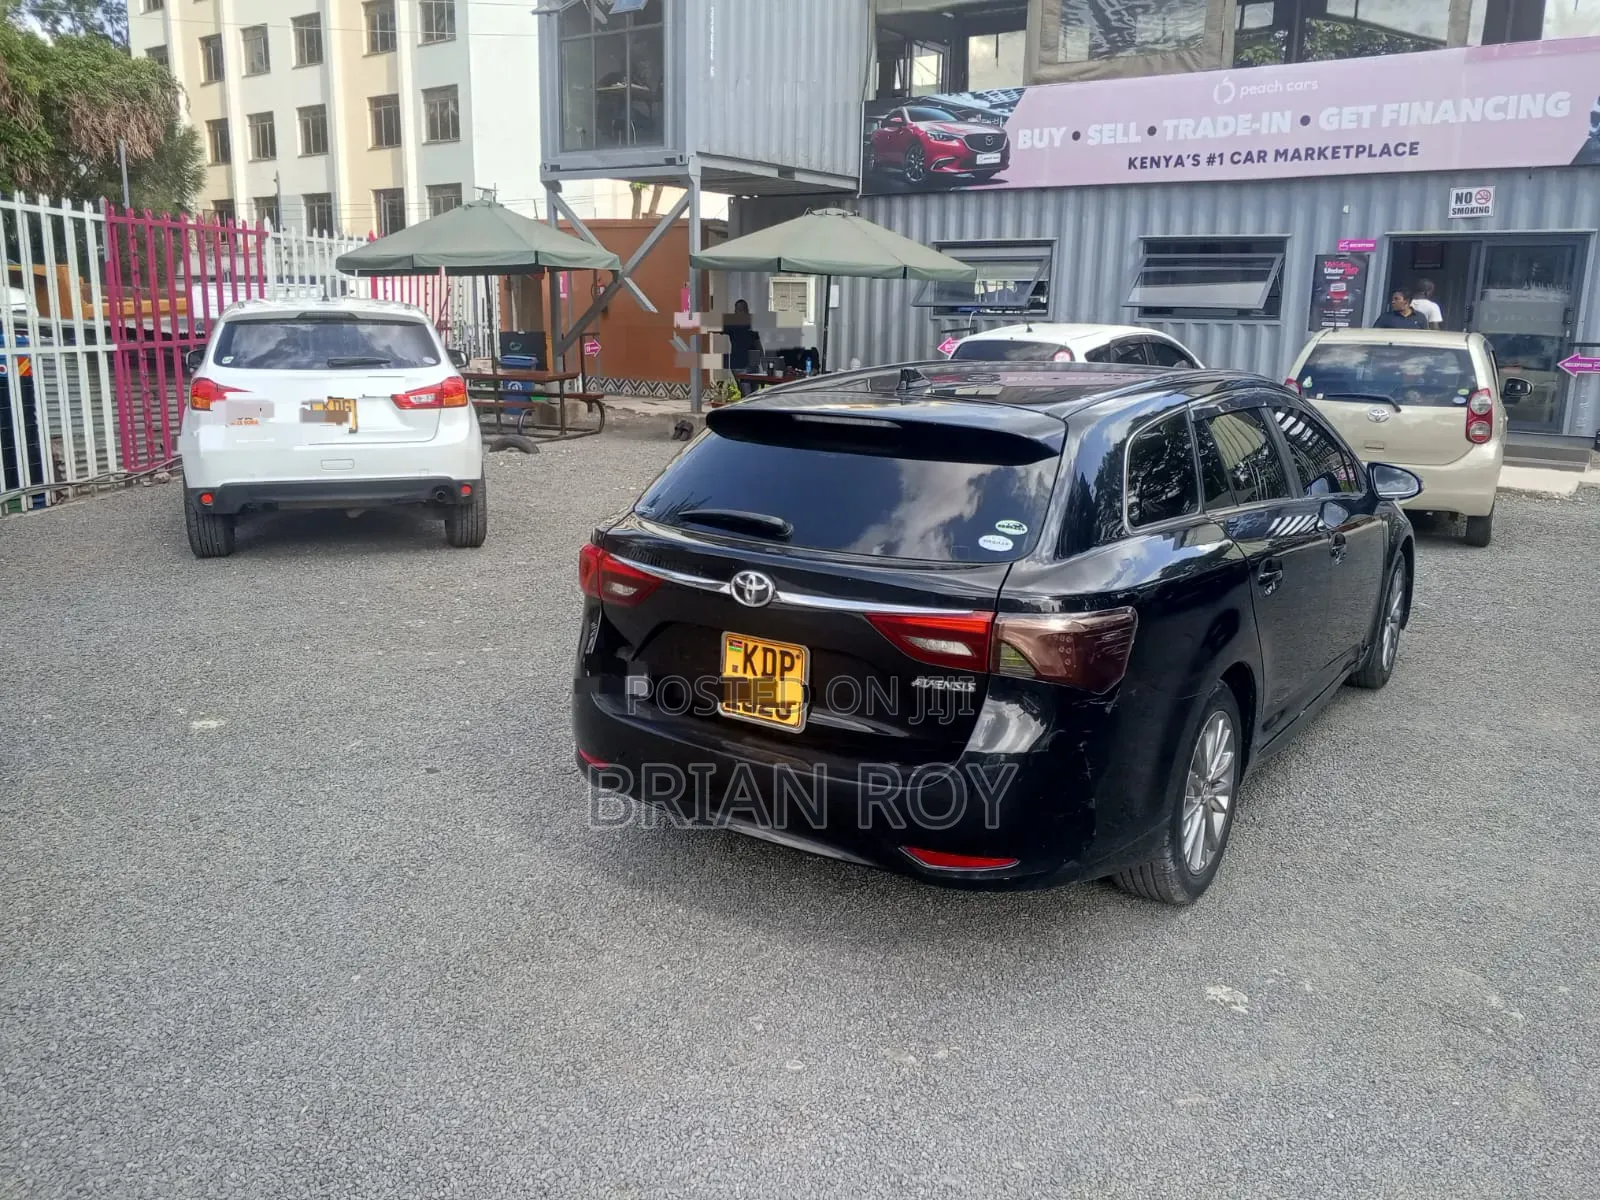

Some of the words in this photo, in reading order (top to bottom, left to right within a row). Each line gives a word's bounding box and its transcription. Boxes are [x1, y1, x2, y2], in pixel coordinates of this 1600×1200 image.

[1240, 79, 1282, 99] peach
[1287, 78, 1319, 92] cars
[1017, 127, 1068, 150] BUY
[1087, 122, 1142, 146] SELL
[1162, 110, 1293, 142] TRADE-IN
[1318, 104, 1377, 131] GET
[1381, 91, 1571, 128] FINANCING
[1127, 154, 1201, 170] KENYA'S
[1206, 152, 1225, 167] #1
[1230, 150, 1267, 165] CAR
[1274, 141, 1420, 163] MARKETPLACE
[1455, 191, 1473, 204] NO
[1451, 206, 1490, 216] SMOKING
[742, 642, 796, 682] KDP
